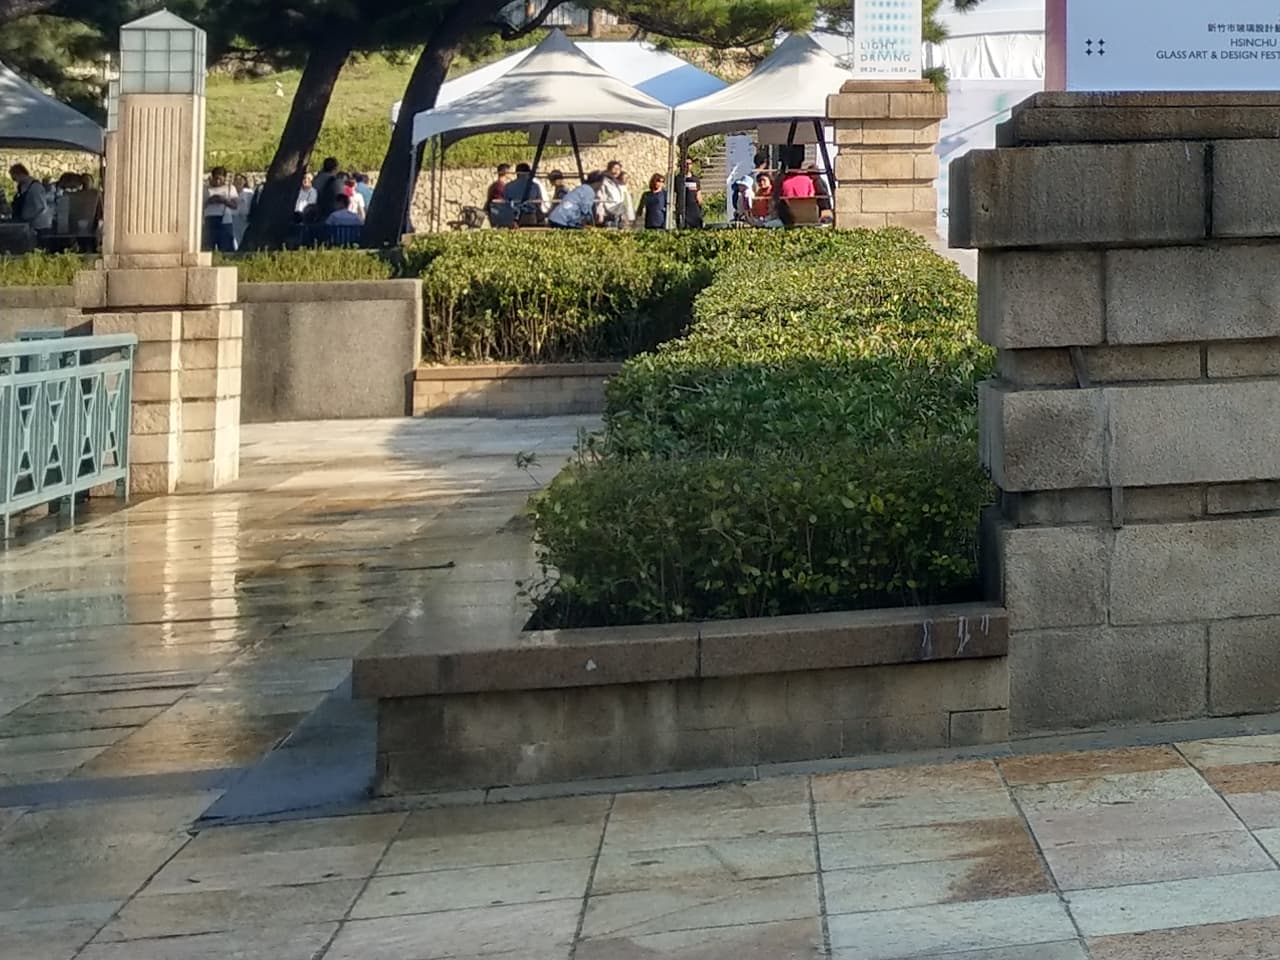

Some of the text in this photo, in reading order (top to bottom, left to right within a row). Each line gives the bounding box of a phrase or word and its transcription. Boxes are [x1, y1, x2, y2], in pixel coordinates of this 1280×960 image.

[860, 41, 897, 50] LIGHT
[1229, 38, 1277, 48] HSINCHU
[860, 54, 911, 62] DRIVING
[1156, 50, 1187, 60] GLASS
[1188, 50, 1208, 60] ART
[1210, 50, 1218, 60] &
[1220, 50, 1258, 60] DESIGN
